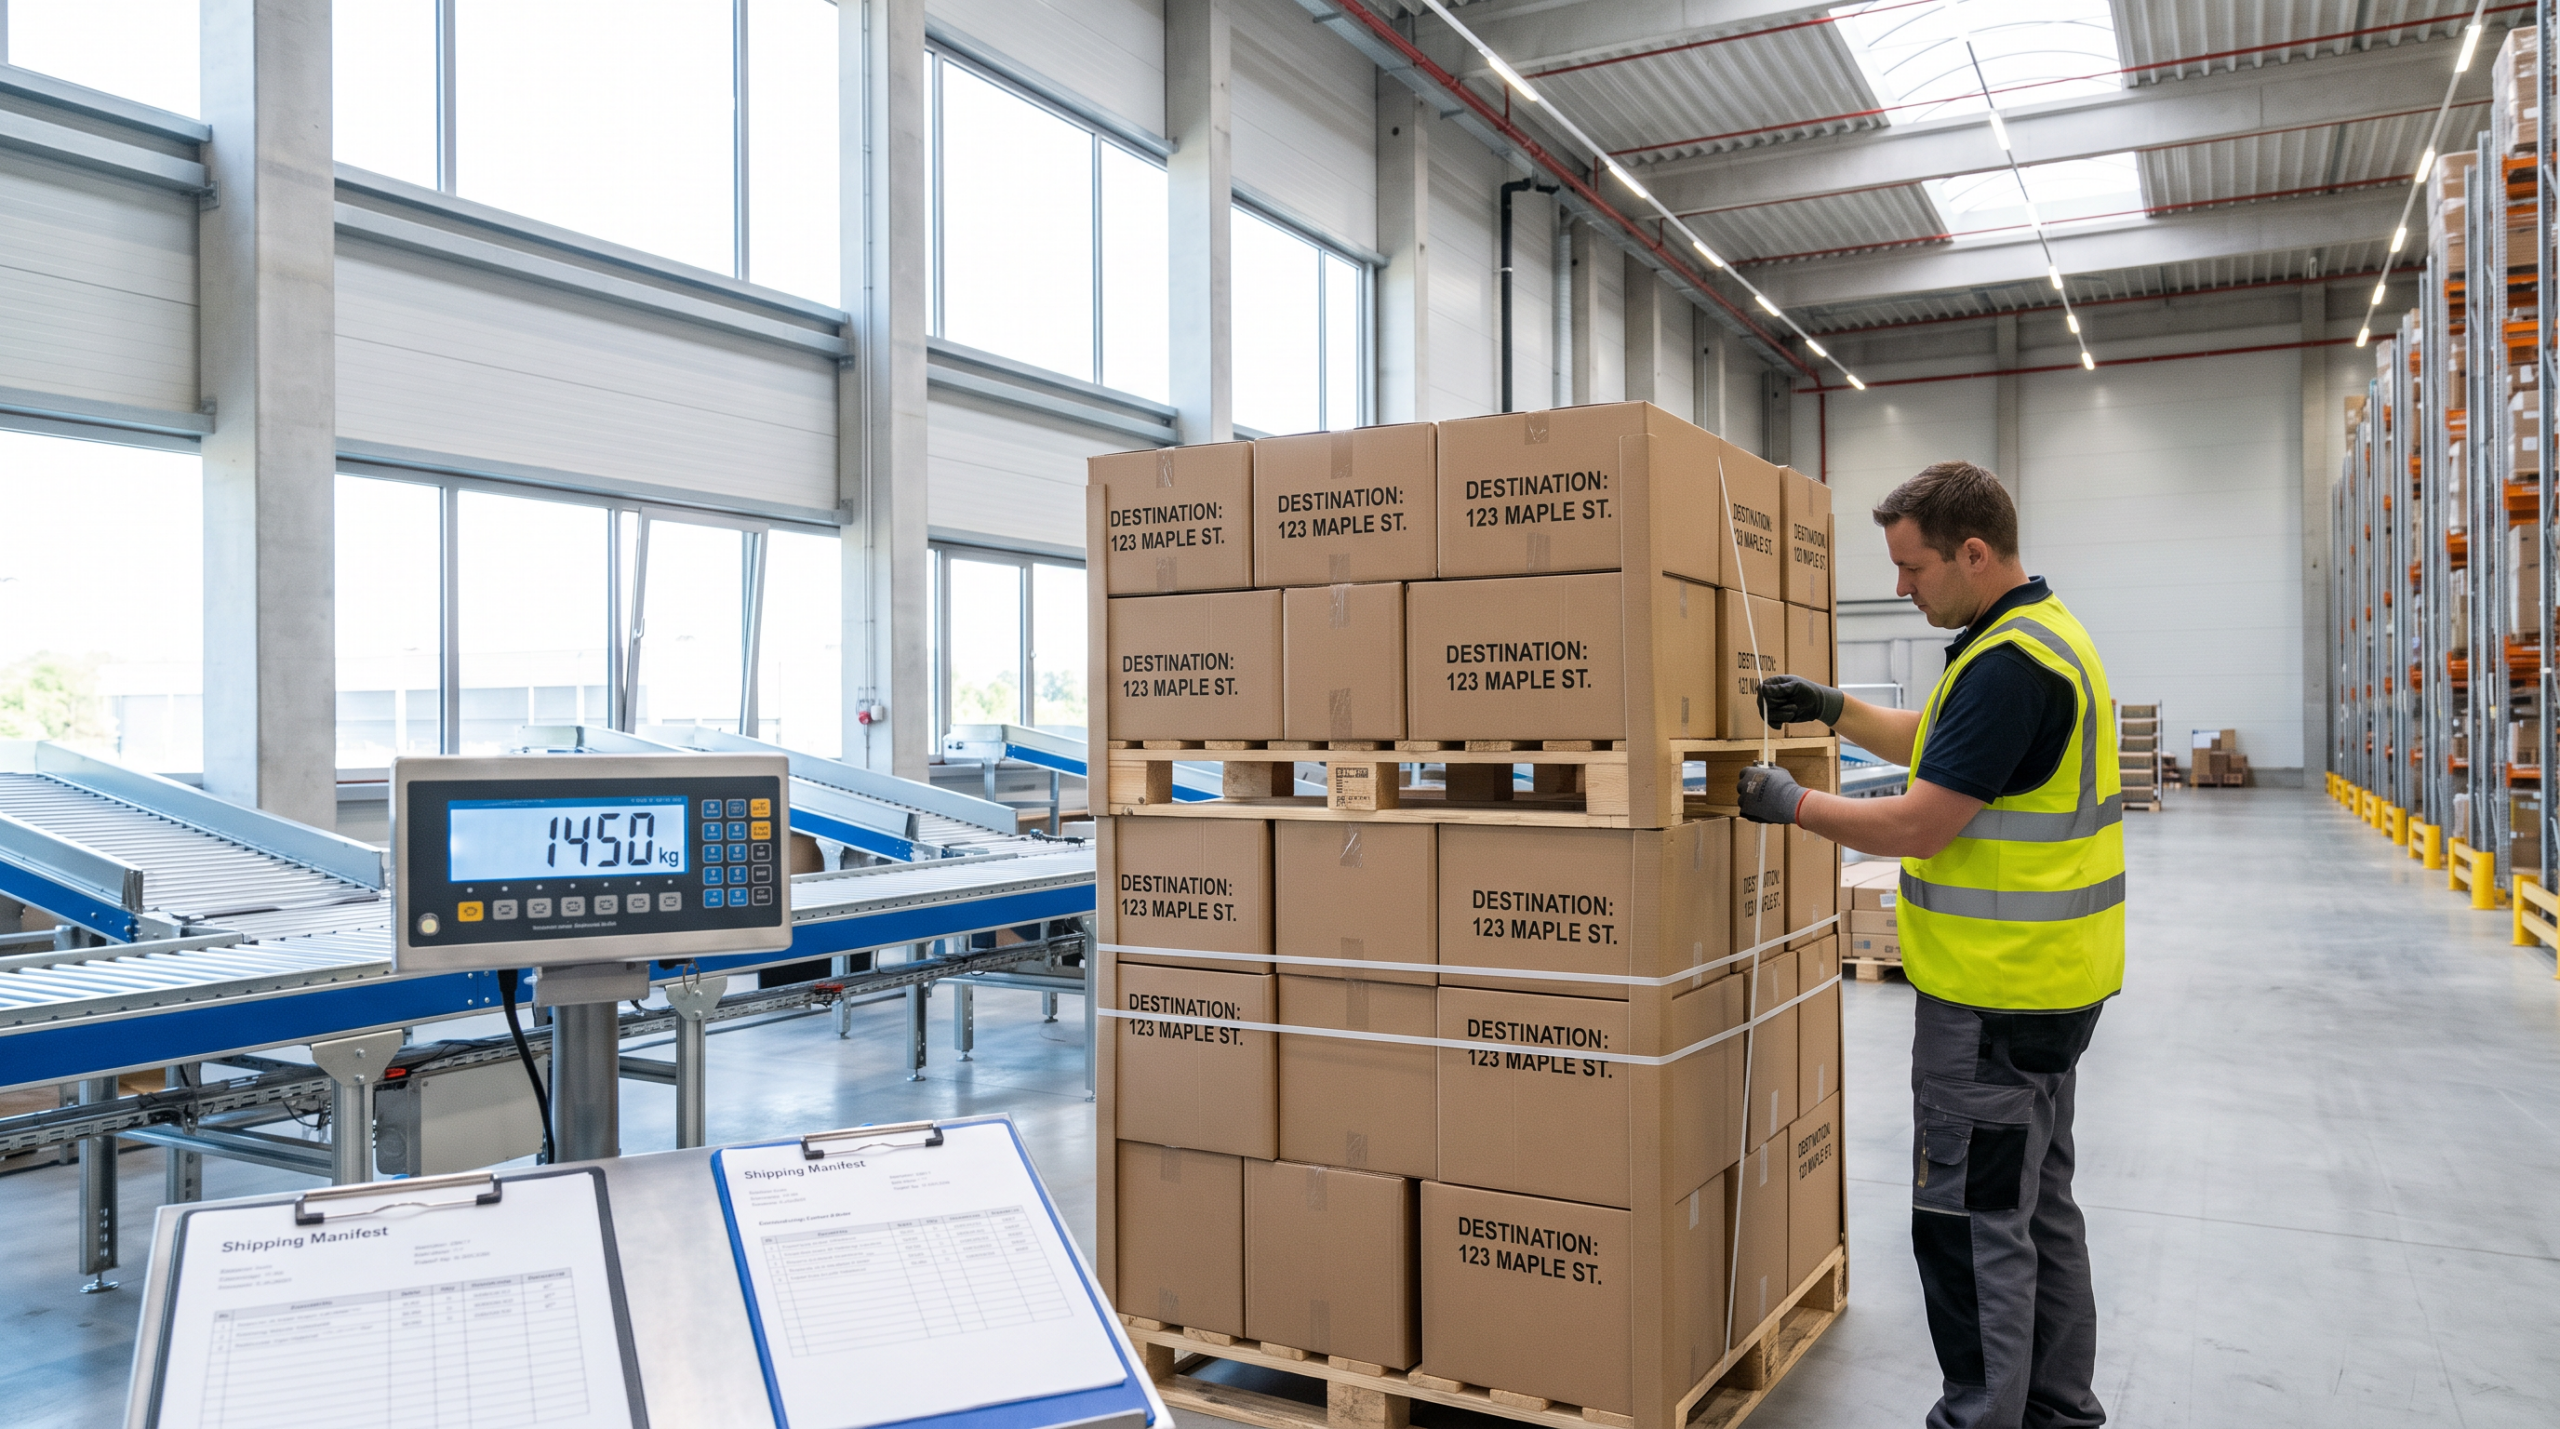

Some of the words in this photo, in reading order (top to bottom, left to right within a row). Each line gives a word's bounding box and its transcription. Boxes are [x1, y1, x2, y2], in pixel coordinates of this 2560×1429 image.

[1467, 471, 1608, 501] DESTINATION:
[1279, 486, 1403, 513] DESTINATION:
[1111, 502, 1222, 529] DESTINATION:
[1279, 520, 1306, 538] 123
[1313, 515, 1374, 536] MAPLE
[1381, 513, 1406, 531] ST.
[1467, 507, 1498, 527] 123
[1506, 502, 1575, 525] MAPLE
[1583, 499, 1611, 519] ST.
[1111, 534, 1136, 551] 123
[1142, 529, 1196, 549] MAPLE
[1202, 527, 1224, 545] ST.
[1123, 653, 1233, 672] DESTINATION:
[1447, 641, 1587, 663] DESTINATION:
[1124, 680, 1148, 697] 123
[1154, 678, 1209, 696] MAPLE
[1215, 678, 1237, 695] ST.
[1447, 672, 1478, 690] 123
[1486, 670, 1555, 690] MAPLE
[1562, 669, 1591, 688] ST.
[548, 813, 654, 867] 1450
[660, 847, 678, 867] kg
[1122, 874, 1232, 896] DESTINATION:
[1122, 899, 1147, 916] 123
[1153, 900, 1208, 919] MAPLE
[1214, 903, 1236, 921] ST.
[1473, 890, 1612, 916] DESTINATION:
[1473, 917, 1504, 937] 123
[1512, 920, 1580, 942] MAPLE
[1588, 924, 1617, 944] ST.
[1130, 994, 1240, 1020] DESTINATION:
[1130, 1019, 1154, 1036] 123
[1160, 1022, 1214, 1042] MAPLE
[1220, 1027, 1243, 1045] ST.
[1468, 1019, 1608, 1049] DESTINATION:
[1468, 1050, 1499, 1067] 123
[1507, 1052, 1575, 1075] MAPLE
[1583, 1059, 1612, 1078] ST.
[744, 1169, 805, 1181] Shipping
[808, 1161, 867, 1172] Manifest
[221, 1238, 305, 1253] Shipping
[311, 1227, 389, 1243] Manifest
[1459, 1217, 1597, 1257] DESTINATION:
[1459, 1244, 1490, 1266] 123
[1497, 1250, 1565, 1279] MAPLE
[1573, 1262, 1601, 1285] ST.
